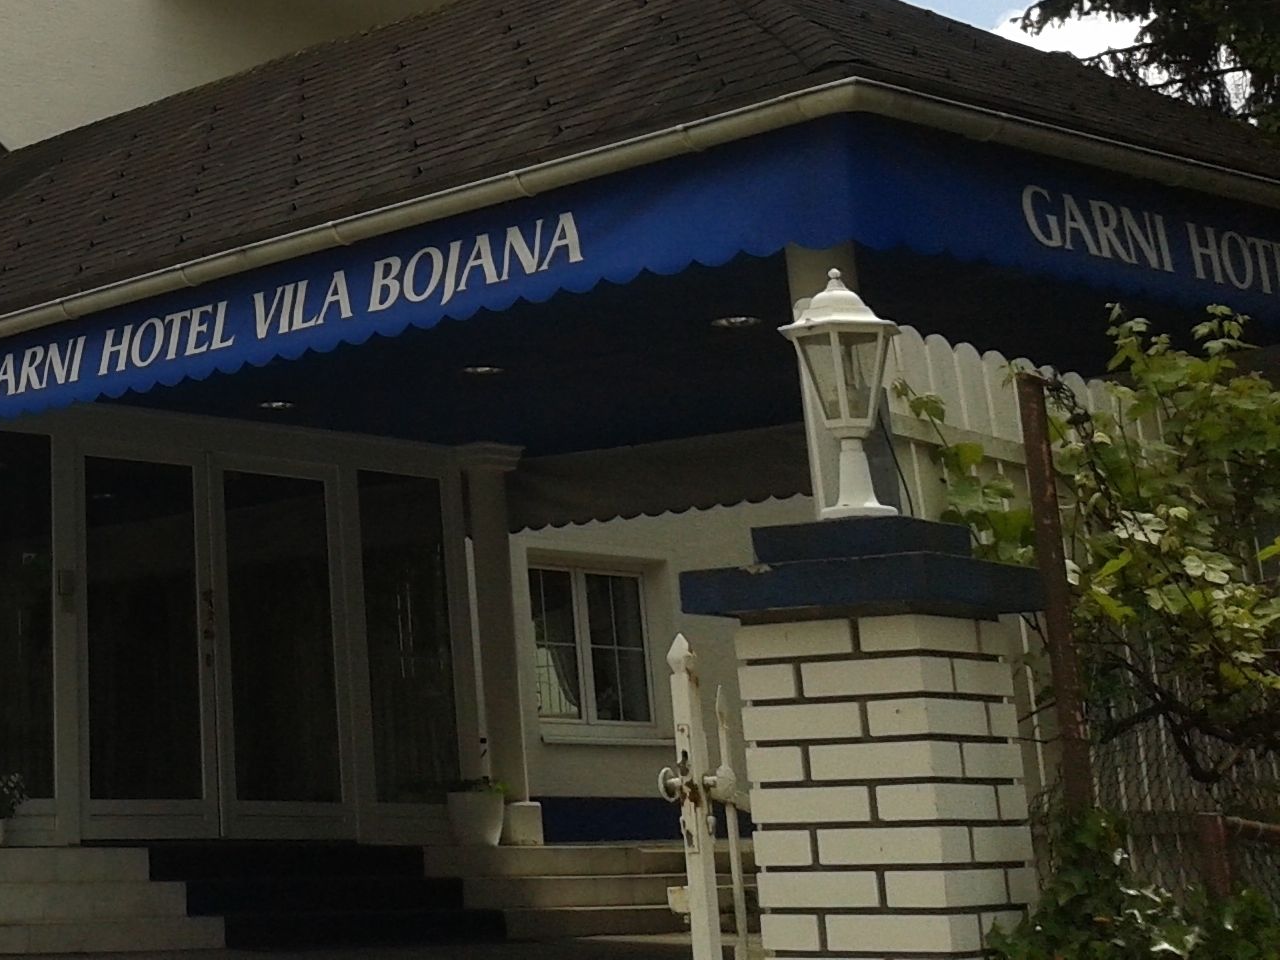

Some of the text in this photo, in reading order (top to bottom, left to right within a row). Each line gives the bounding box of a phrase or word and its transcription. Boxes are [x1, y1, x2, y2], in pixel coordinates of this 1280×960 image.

[1022, 184, 1175, 273] GARNI
[98, 301, 235, 377] HOTEL
[252, 270, 352, 340] VILA
[368, 211, 584, 314] BOJANA
